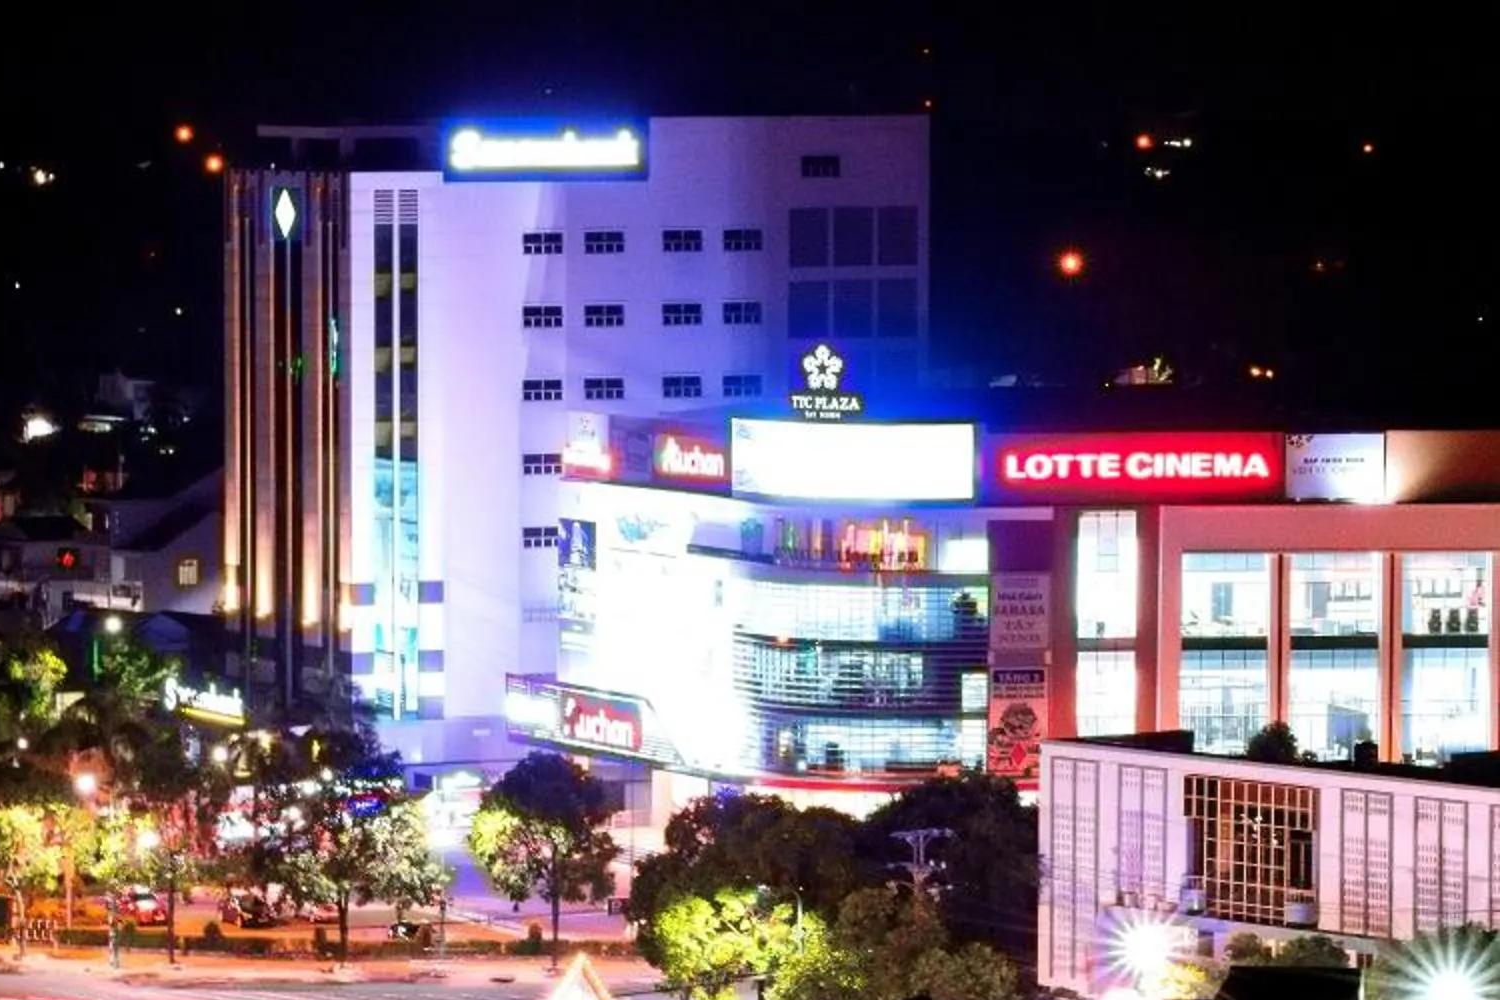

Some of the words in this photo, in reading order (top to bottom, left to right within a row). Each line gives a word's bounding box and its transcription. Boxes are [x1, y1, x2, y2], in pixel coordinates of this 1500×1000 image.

[791, 395, 813, 409] TTC
[814, 396, 861, 411] PLAZA
[661, 436, 725, 477] Auchan
[1005, 453, 1120, 479] LOTTE
[1125, 452, 1270, 479] CINEMA
